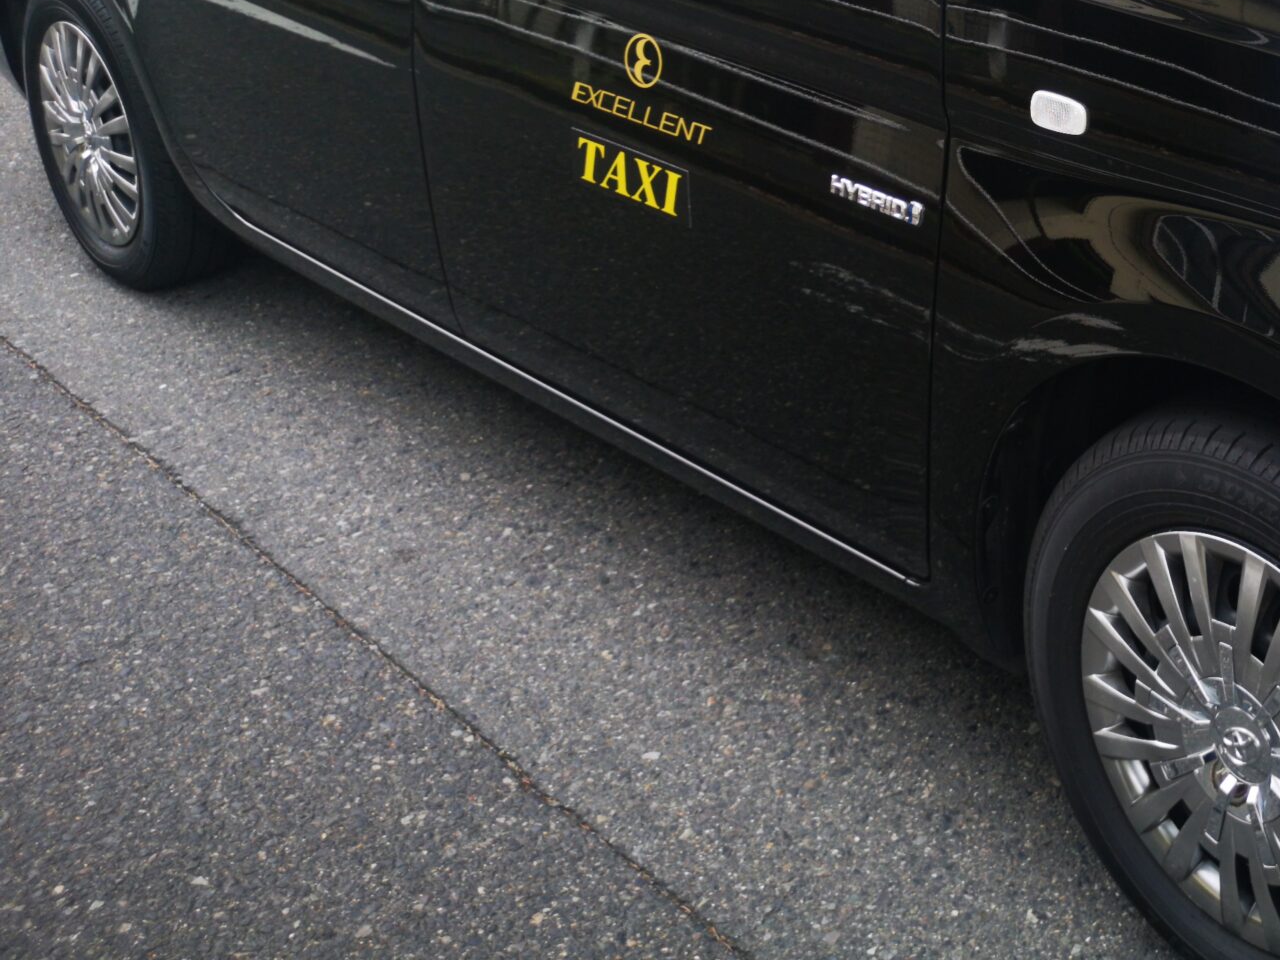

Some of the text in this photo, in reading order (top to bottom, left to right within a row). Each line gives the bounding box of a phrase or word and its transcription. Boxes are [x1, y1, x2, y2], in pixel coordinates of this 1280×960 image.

[571, 81, 713, 145] EXCELLENT
[578, 136, 682, 217] TAXI
[830, 174, 908, 220] HYBRID
